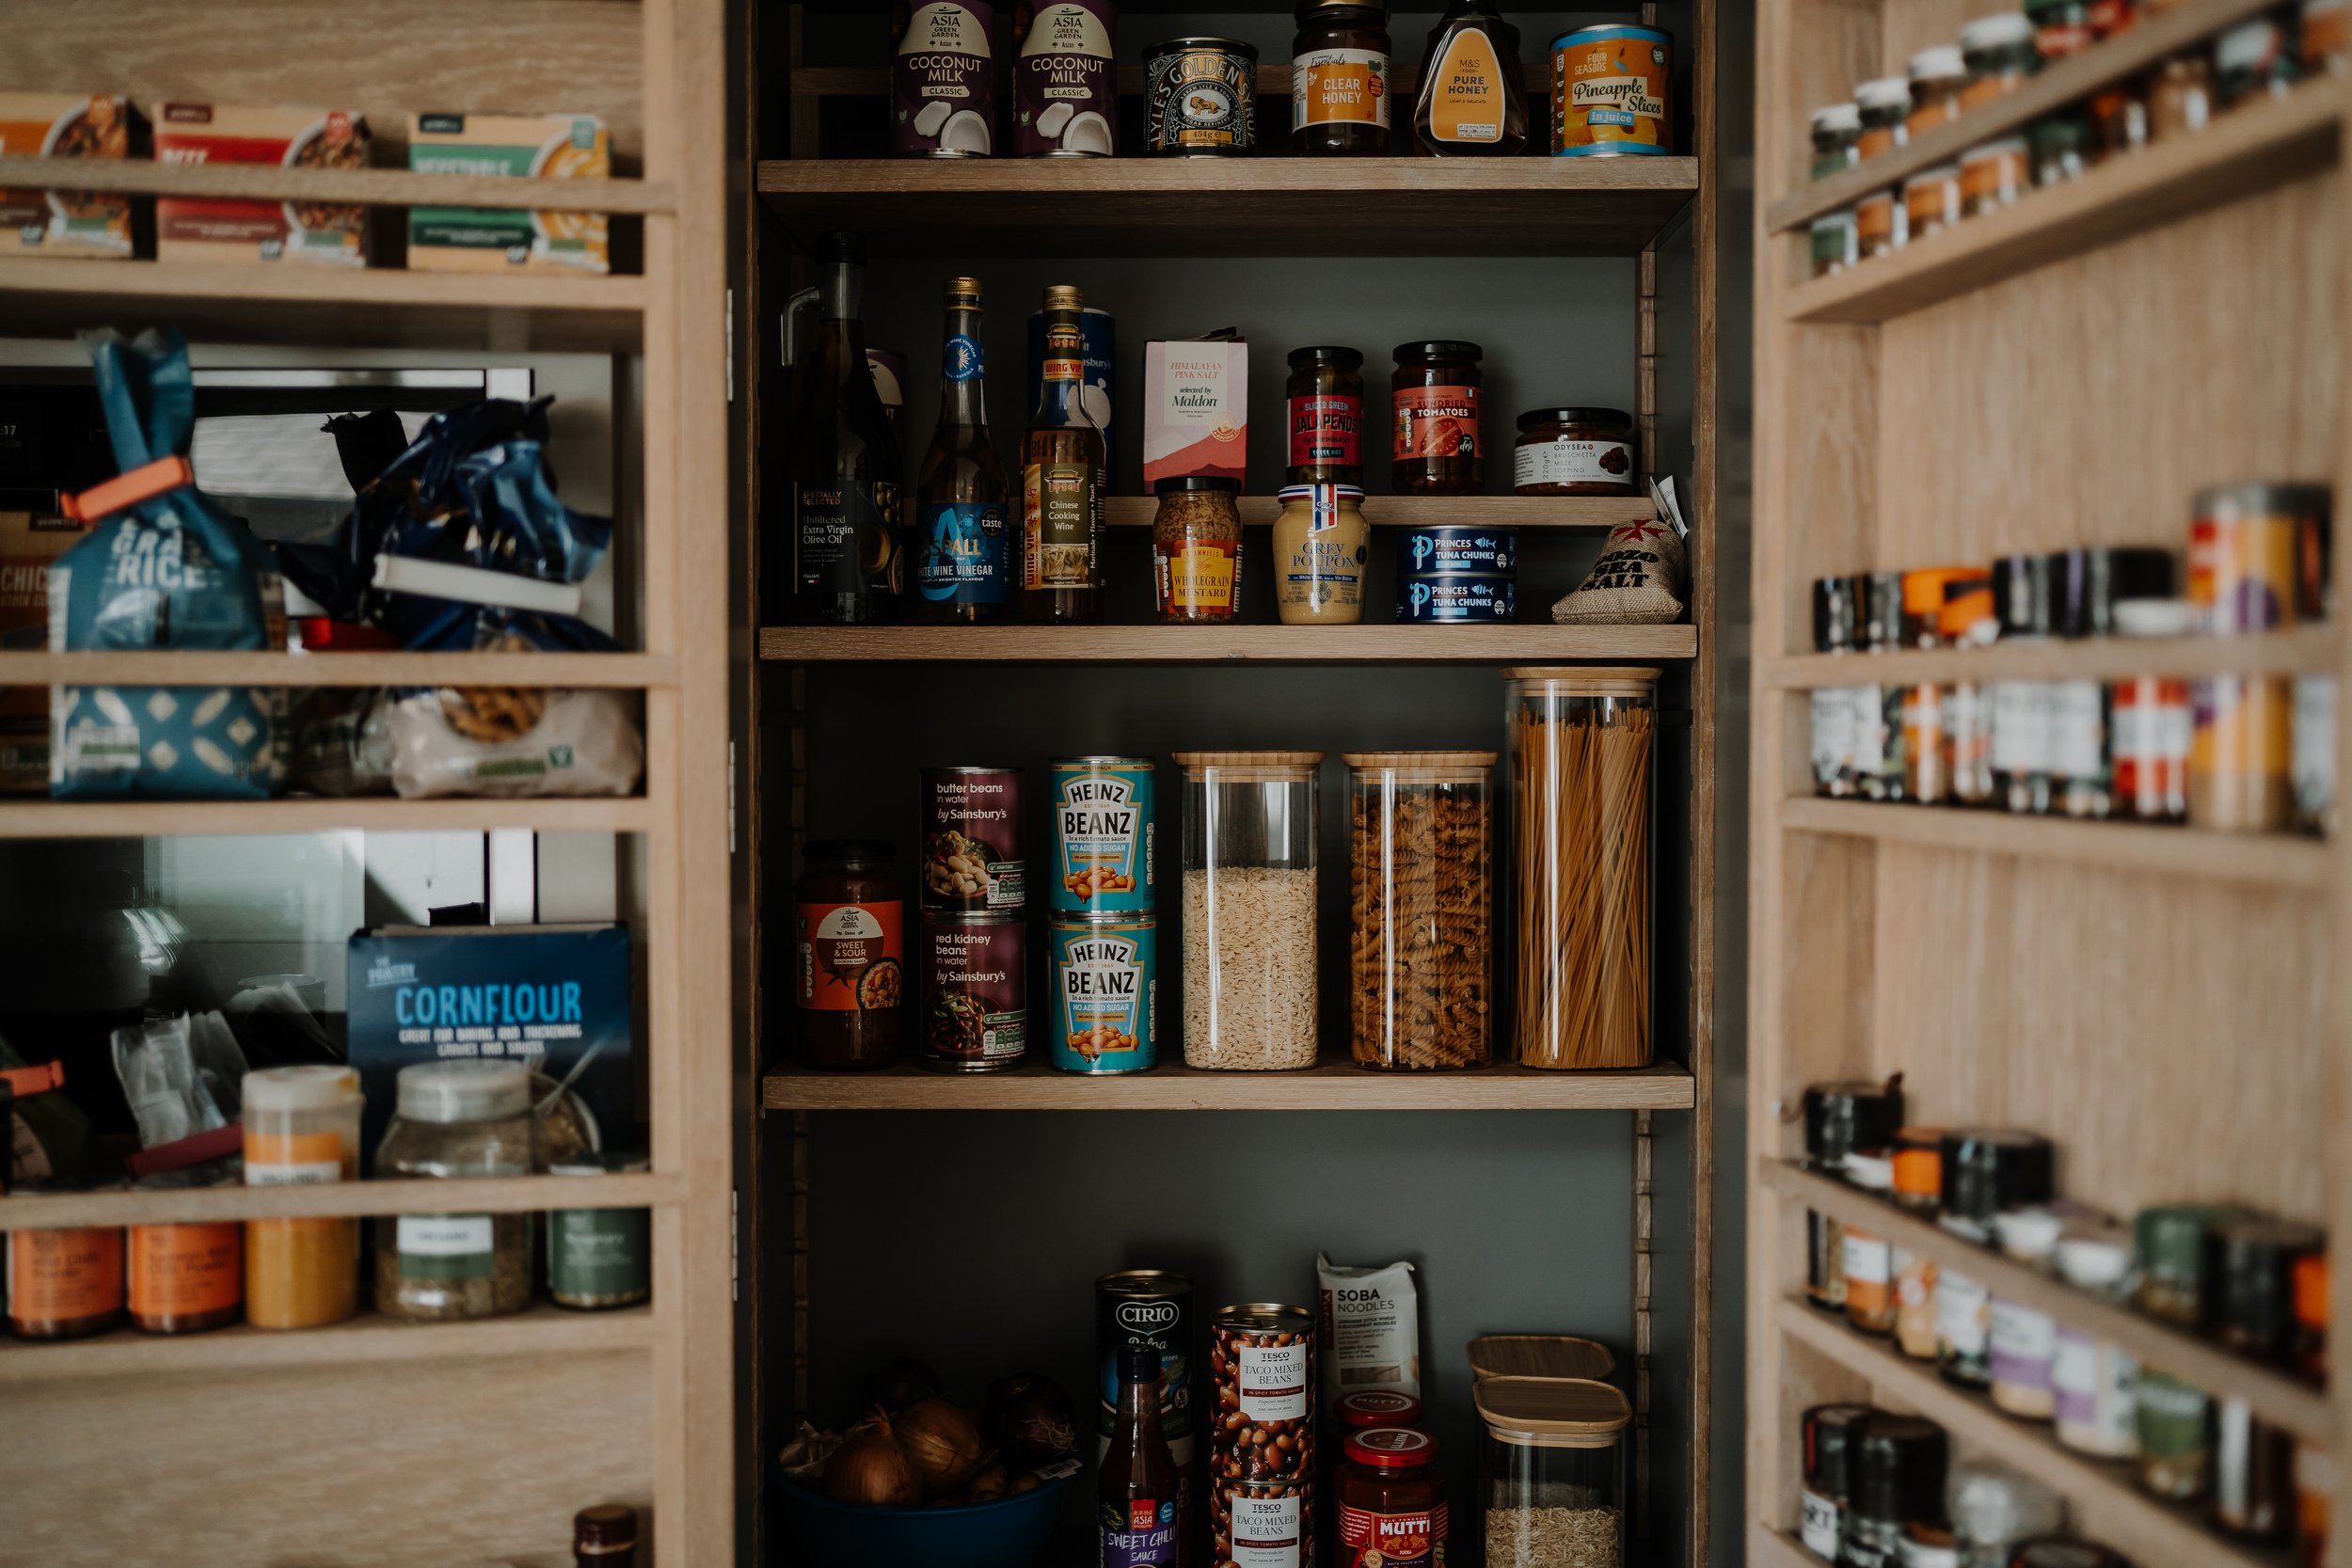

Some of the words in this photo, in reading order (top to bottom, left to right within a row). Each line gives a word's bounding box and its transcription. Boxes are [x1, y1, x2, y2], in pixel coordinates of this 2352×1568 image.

[930, 16, 961, 27] ASIA
[1053, 17, 1083, 28] ASIA
[909, 55, 981, 72] COCONUT
[1311, 54, 1346, 68] Essentials
[1588, 53, 1607, 63] FOUR
[1031, 57, 1104, 73] COCONUT
[1575, 62, 1607, 75] SEASONS
[929, 69, 963, 83] MILK
[1050, 71, 1086, 84] MILK
[1324, 79, 1360, 90] CLEAR
[1449, 86, 1489, 94] HONEY
[1574, 78, 1643, 100] Pineapple
[1052, 88, 1085, 97] CLASSIC
[1322, 92, 1361, 104] HONEY
[1169, 57, 1239, 85] GOLDEN
[1238, 83, 1255, 144] SYRUP
[1628, 95, 1661, 114] Slices
[1592, 112, 1602, 121] in
[1603, 112, 1632, 123] juice
[1046, 363, 1068, 372] WING
[1070, 364, 1082, 372] YIP
[1172, 395, 1218, 406] Maldon
[1304, 402, 1327, 411] SLICED
[1328, 402, 1348, 411] GREEN
[1418, 408, 1468, 417] TOMATOES
[1295, 411, 1358, 433] JALAPEÑOS
[1459, 439, 1473, 451] deli
[1050, 500, 1078, 509] Chinese
[1048, 512, 1080, 521] Cooking
[981, 519, 1002, 528] taste
[1055, 522, 1074, 531] Wine
[803, 526, 824, 534] Extra
[827, 525, 854, 535] Virgin
[803, 535, 825, 544] Olive
[828, 535, 842, 544] Oil
[1435, 539, 1471, 547] PRINCES
[1302, 543, 1343, 554] GREY
[1294, 555, 1355, 567] POUPON
[1436, 551, 1461, 560] TUNA
[1462, 551, 1494, 560] CHUNKS
[116, 555, 208, 588] RICE
[933, 565, 953, 576] WINE
[956, 565, 993, 575] VINEGAR
[1594, 562, 1642, 579] SEA
[1174, 577, 1230, 586] WHOLEGRAIN
[1581, 575, 1649, 591] SALT
[1431, 586, 1469, 595] PRINCES
[937, 784, 967, 793] butter
[970, 784, 1003, 793] beans
[1071, 784, 1124, 802] HEINZ
[937, 795, 944, 803] in
[945, 795, 968, 803] water
[937, 809, 949, 822] by
[950, 808, 1007, 821] Sainsbury's
[1065, 812, 1131, 834] BEANZ
[936, 934, 951, 943] red
[955, 934, 991, 946] kidney
[936, 945, 967, 955] beans
[1073, 943, 1128, 962] HEINZ
[936, 957, 943, 965] in
[945, 958, 967, 966] water
[936, 970, 947, 984] by
[949, 970, 1006, 983] Sainsbury's
[1069, 972, 1135, 993] BEANZ
[394, 981, 583, 1025] CORNFLOUR
[497, 1024, 521, 1040] AND
[481, 1041, 504, 1055] AND
[1338, 1289, 1380, 1301] SOBA
[1338, 1300, 1394, 1312] NOODLES
[1121, 1307, 1174, 1323] CIRIO
[1244, 1365, 1271, 1374] TACO
[1275, 1363, 1303, 1373] MIXED
[1260, 1374, 1292, 1384] BEANS
[1134, 1516, 1152, 1525] ASIA
[1236, 1515, 1262, 1526] TACO
[1265, 1515, 1296, 1526] MIXED
[1250, 1527, 1283, 1535] BEANS
[1380, 1520, 1431, 1535] MUTTI
[1108, 1532, 1148, 1549] SWEET
[1131, 1550, 1157, 1562] SAUCE
